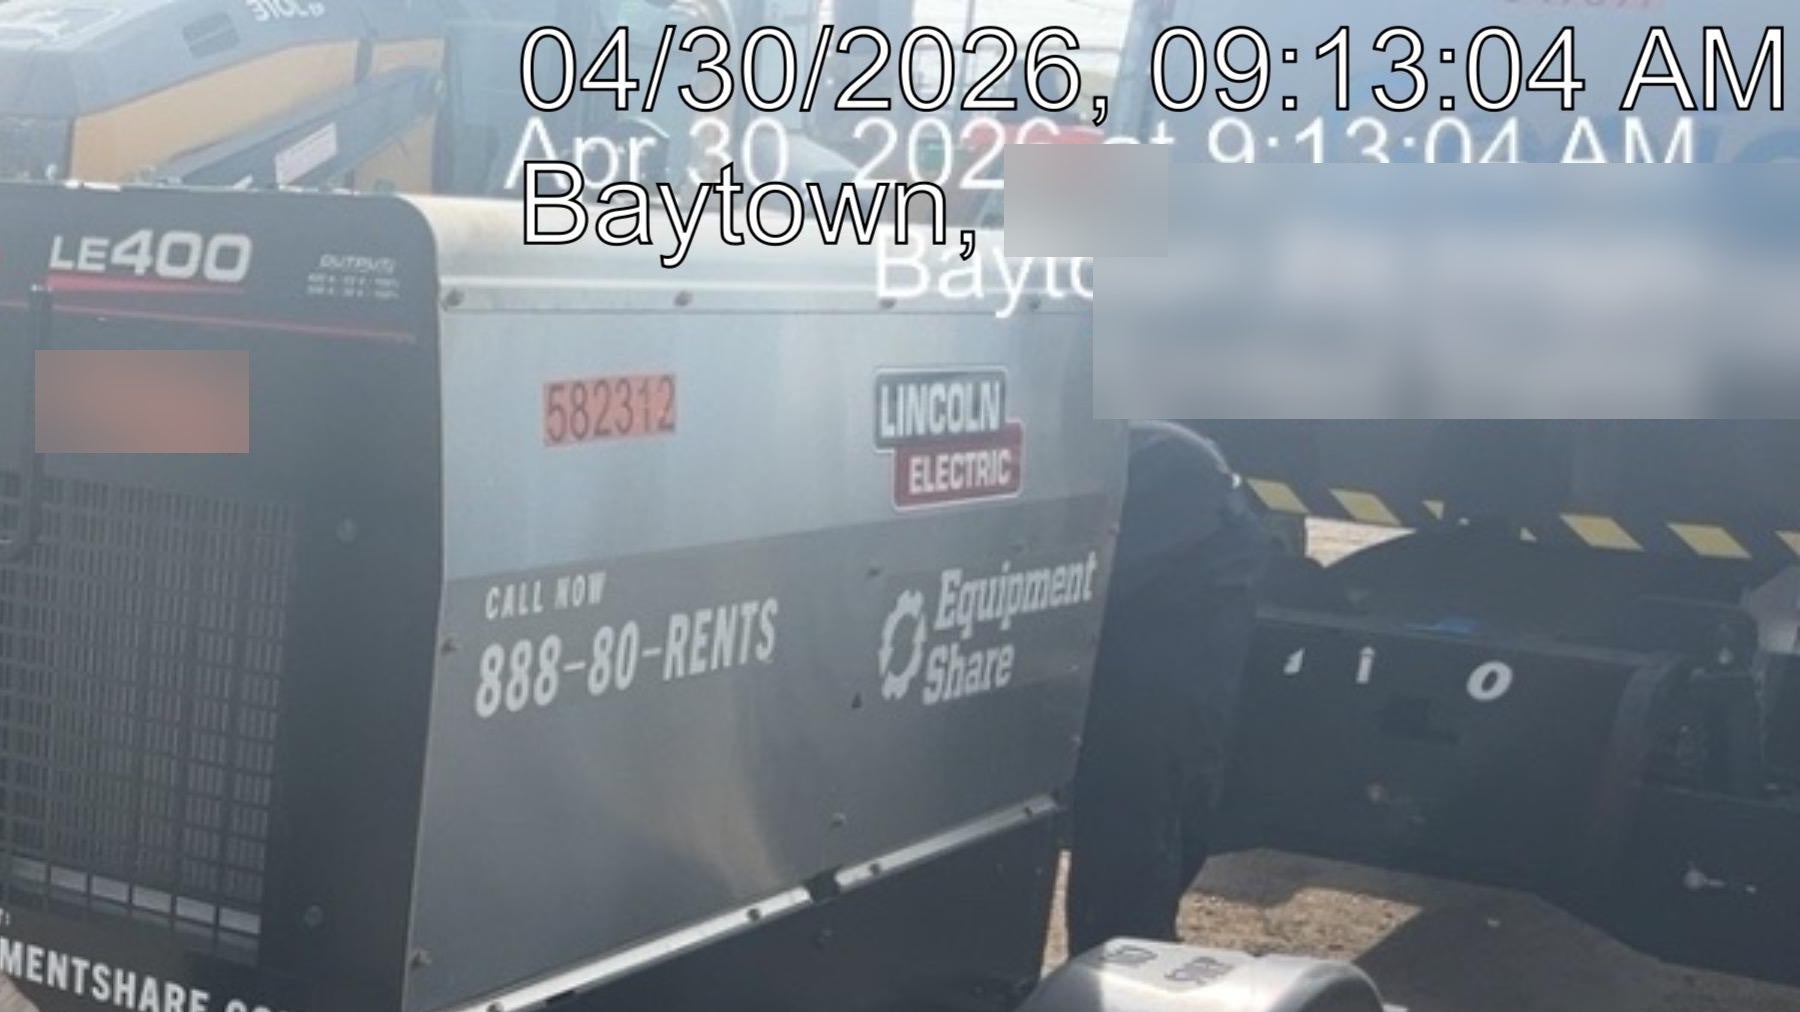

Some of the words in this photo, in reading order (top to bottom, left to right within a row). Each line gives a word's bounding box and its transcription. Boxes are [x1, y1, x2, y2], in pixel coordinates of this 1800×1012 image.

[50, 229, 253, 283] LE400
[546, 375, 676, 442] 582312
[880, 380, 1001, 438] LINCOLN
[908, 448, 1012, 495] ELECTRIC
[485, 580, 544, 620] CALL
[555, 570, 606, 609] NOW
[934, 551, 1097, 639] Equipment
[475, 597, 778, 718] 888-80-RENTS
[923, 642, 1015, 705] Share
